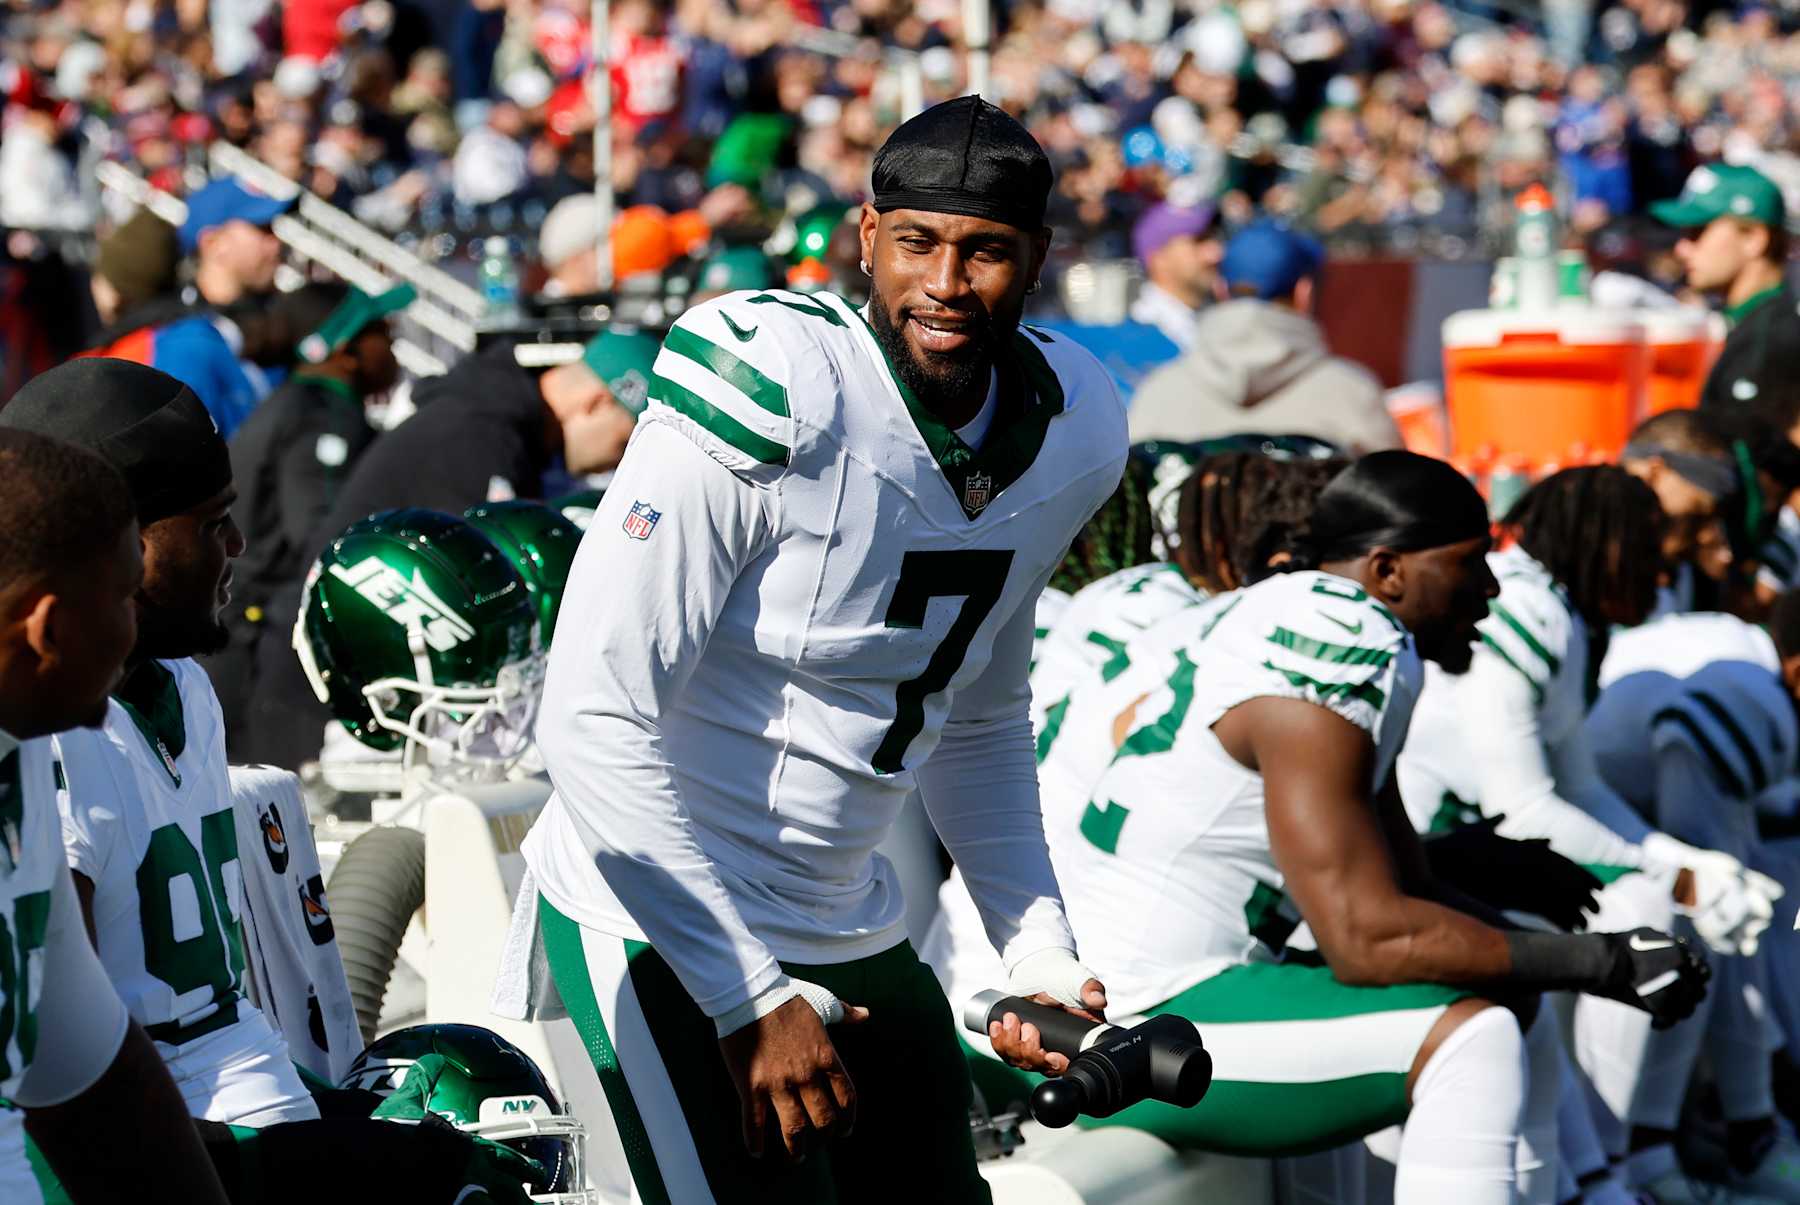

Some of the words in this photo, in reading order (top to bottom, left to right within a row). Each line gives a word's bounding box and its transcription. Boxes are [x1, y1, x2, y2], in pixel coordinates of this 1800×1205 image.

[625, 512, 651, 538] NFL
[328, 556, 477, 652] JETS
[871, 549, 1016, 775] 7
